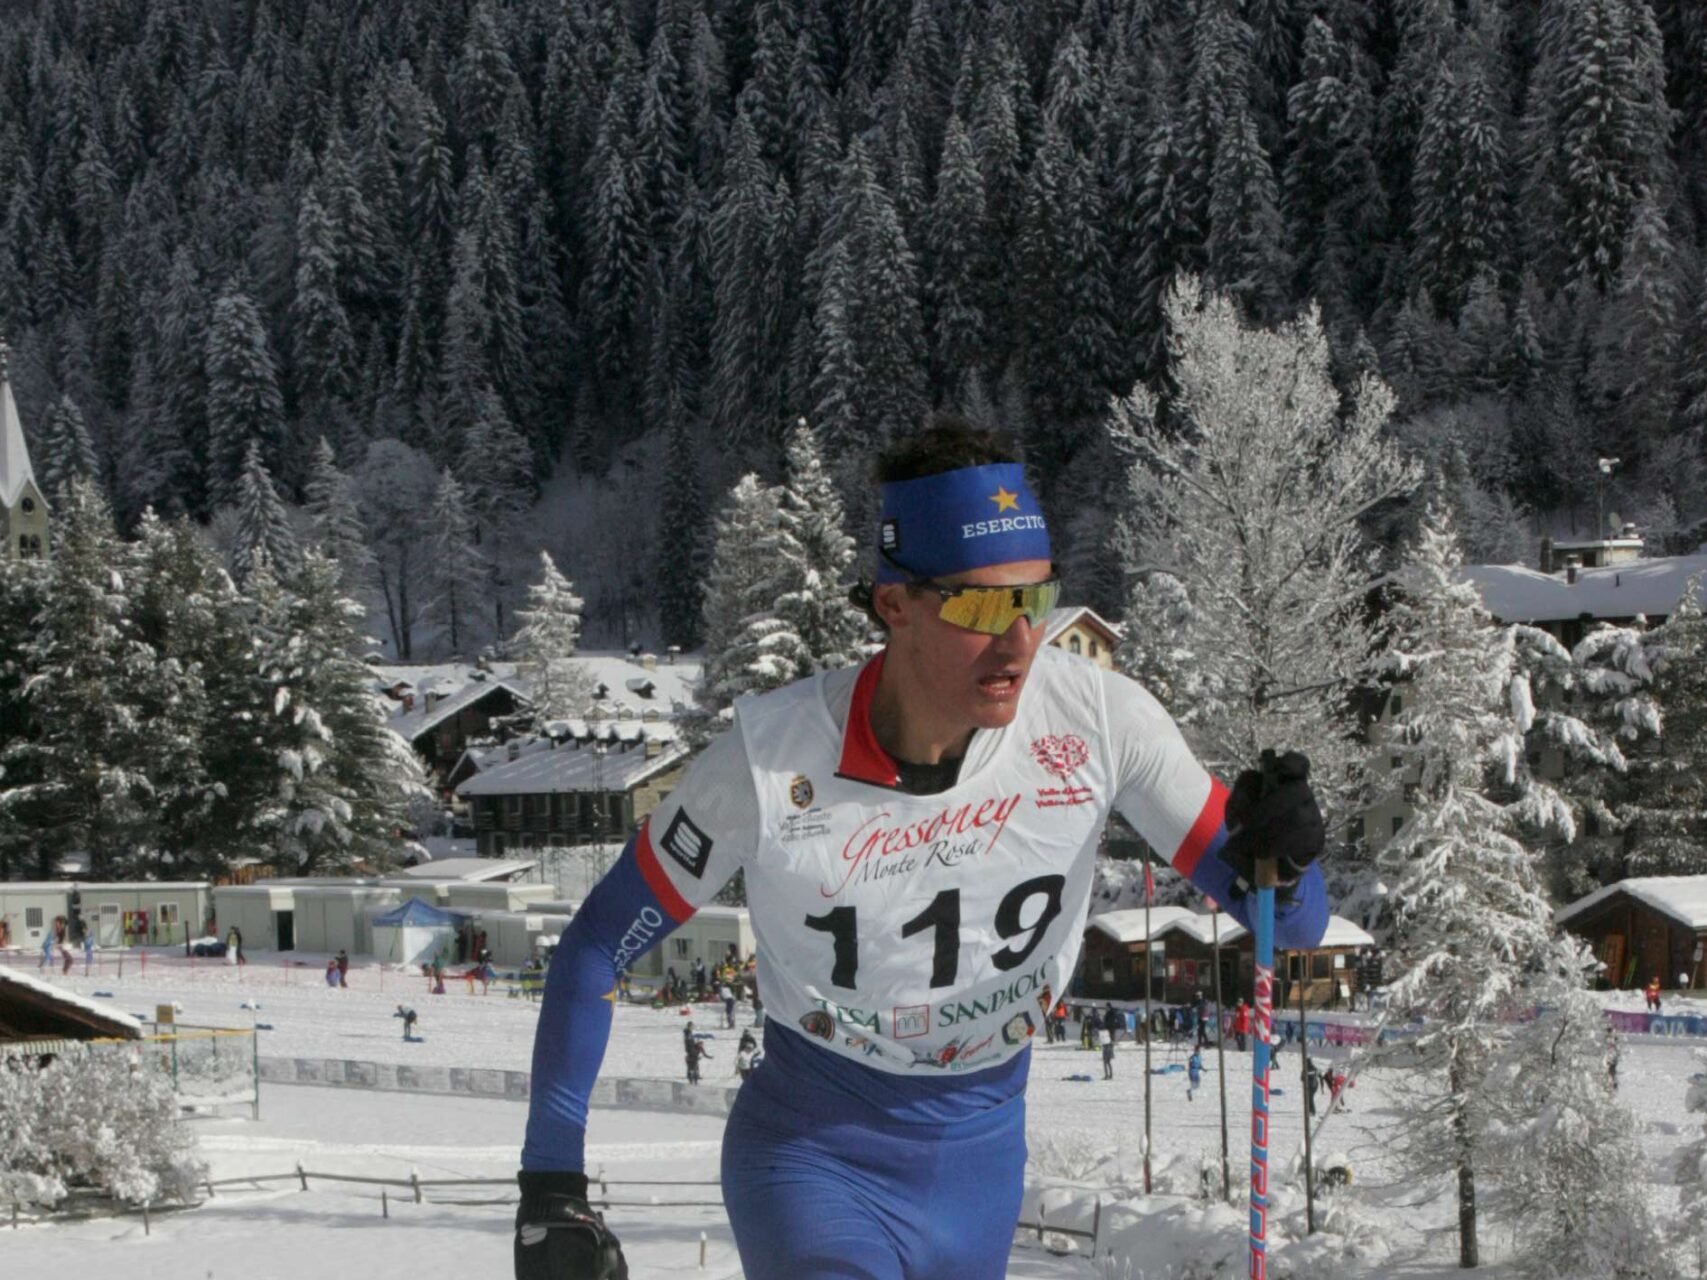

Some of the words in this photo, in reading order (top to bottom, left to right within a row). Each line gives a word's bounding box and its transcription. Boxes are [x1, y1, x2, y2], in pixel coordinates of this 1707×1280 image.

[962, 515, 1046, 539] ESERCITO
[821, 793, 1021, 898] Gressoney
[855, 852, 918, 886] Monte
[924, 838, 983, 867] Rosa
[805, 874, 1066, 991] 119
